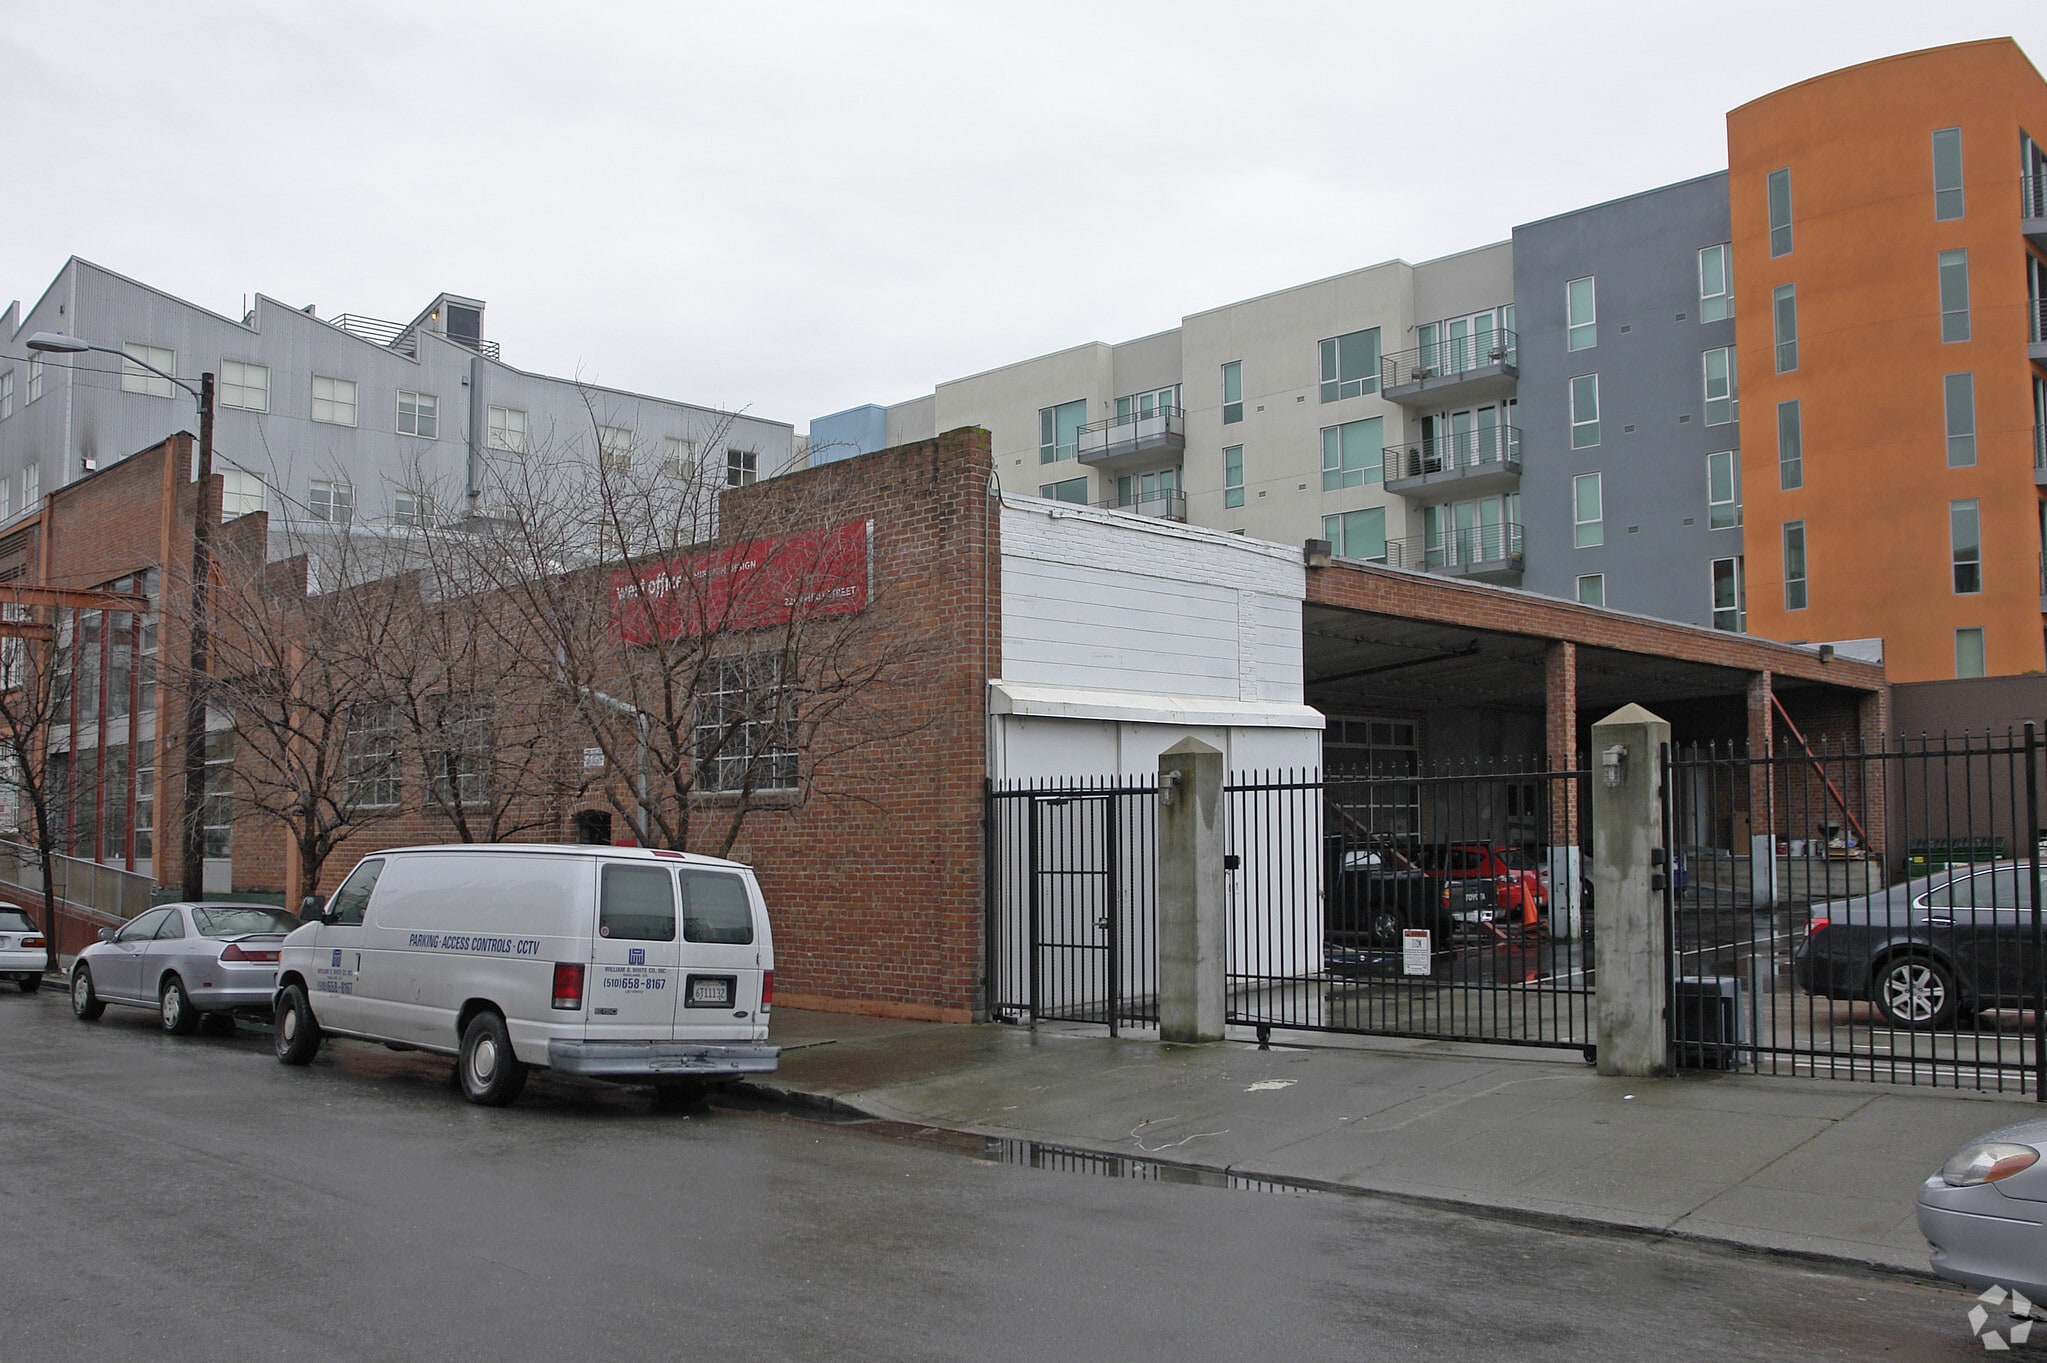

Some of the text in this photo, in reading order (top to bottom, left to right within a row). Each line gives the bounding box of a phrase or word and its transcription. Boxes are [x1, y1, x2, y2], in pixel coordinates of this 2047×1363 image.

[648, 571, 683, 599] office
[408, 933, 541, 955] PARKING ACCESS CONTROLS CCTV
